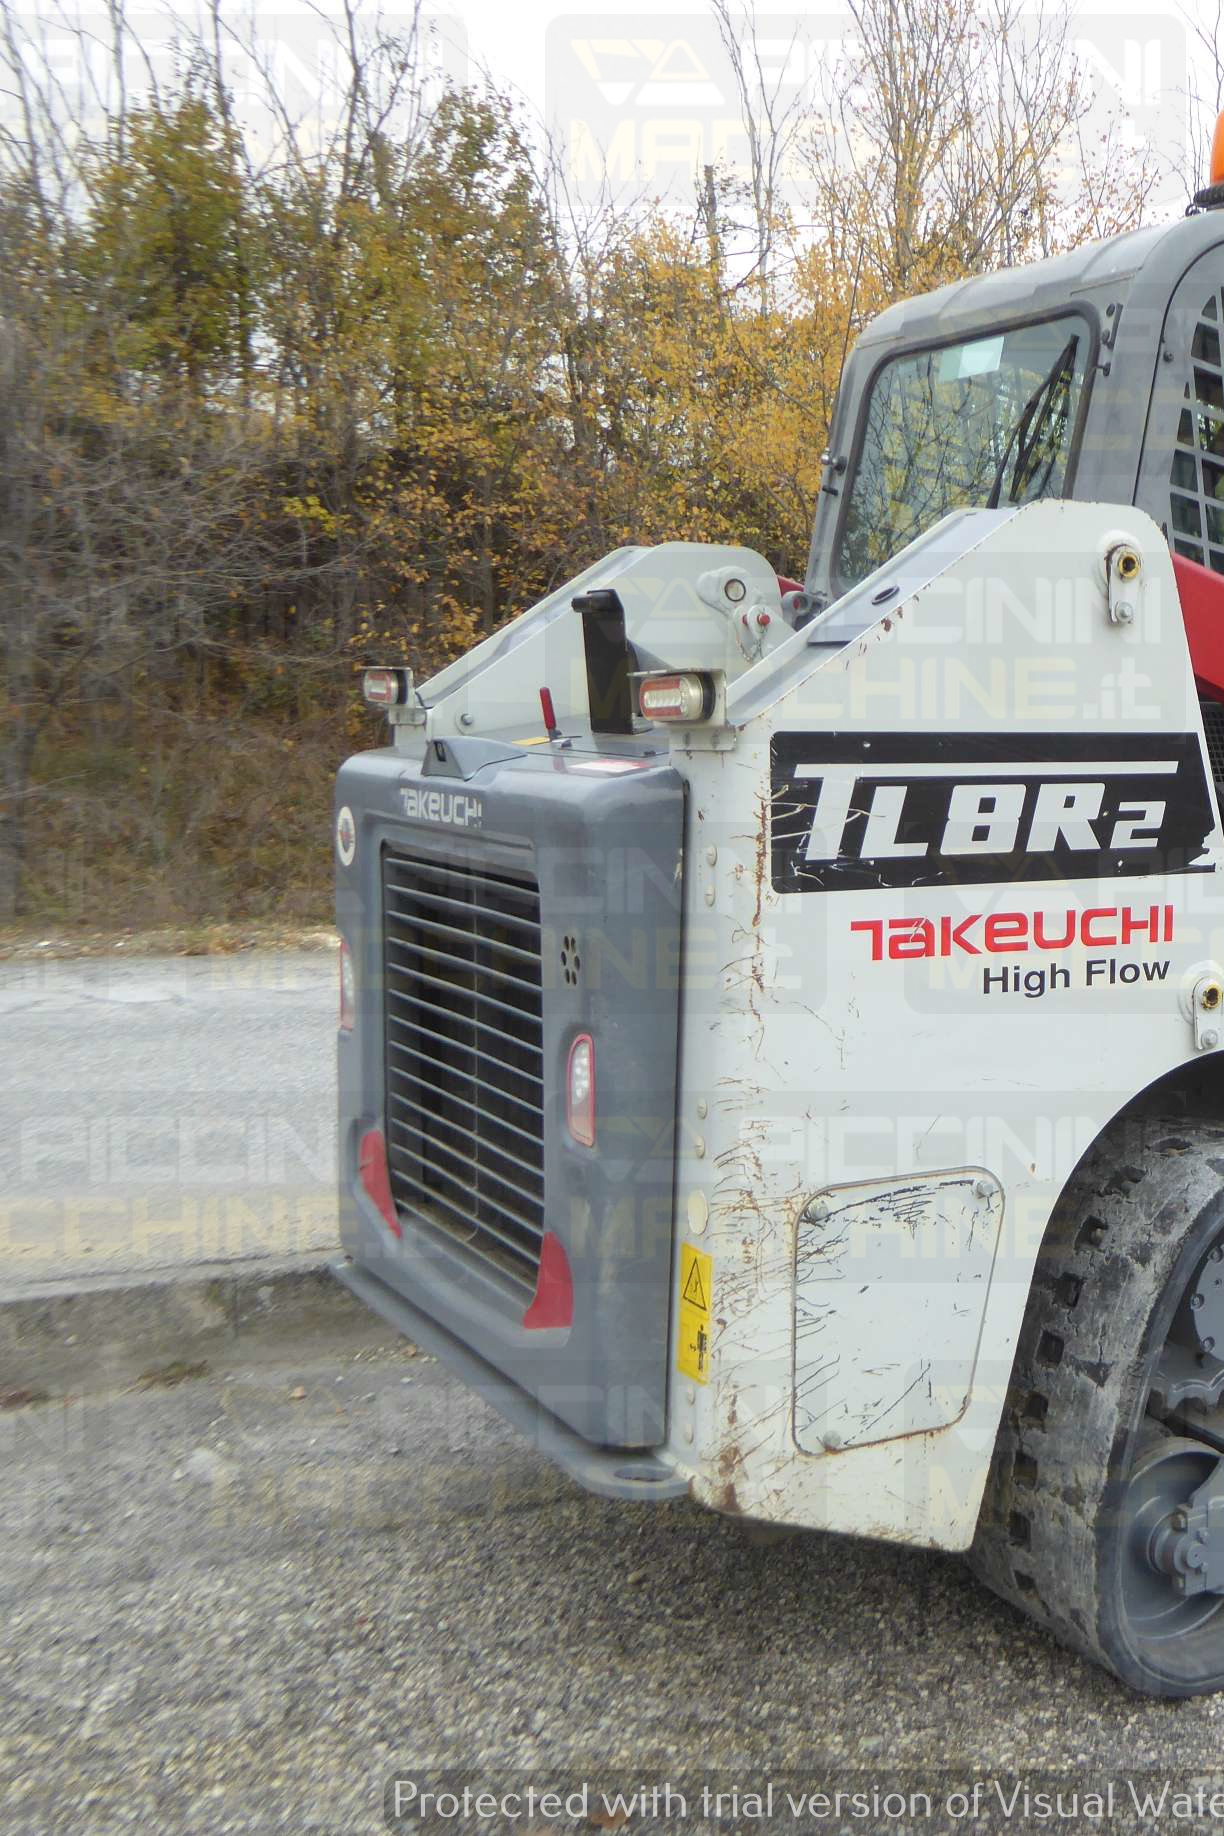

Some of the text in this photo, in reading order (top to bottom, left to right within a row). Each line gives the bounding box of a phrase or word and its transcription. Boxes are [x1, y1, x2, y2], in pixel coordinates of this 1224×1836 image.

[850, 904, 1174, 961] TAKEUCHI
[982, 959, 1171, 998] High Flow
